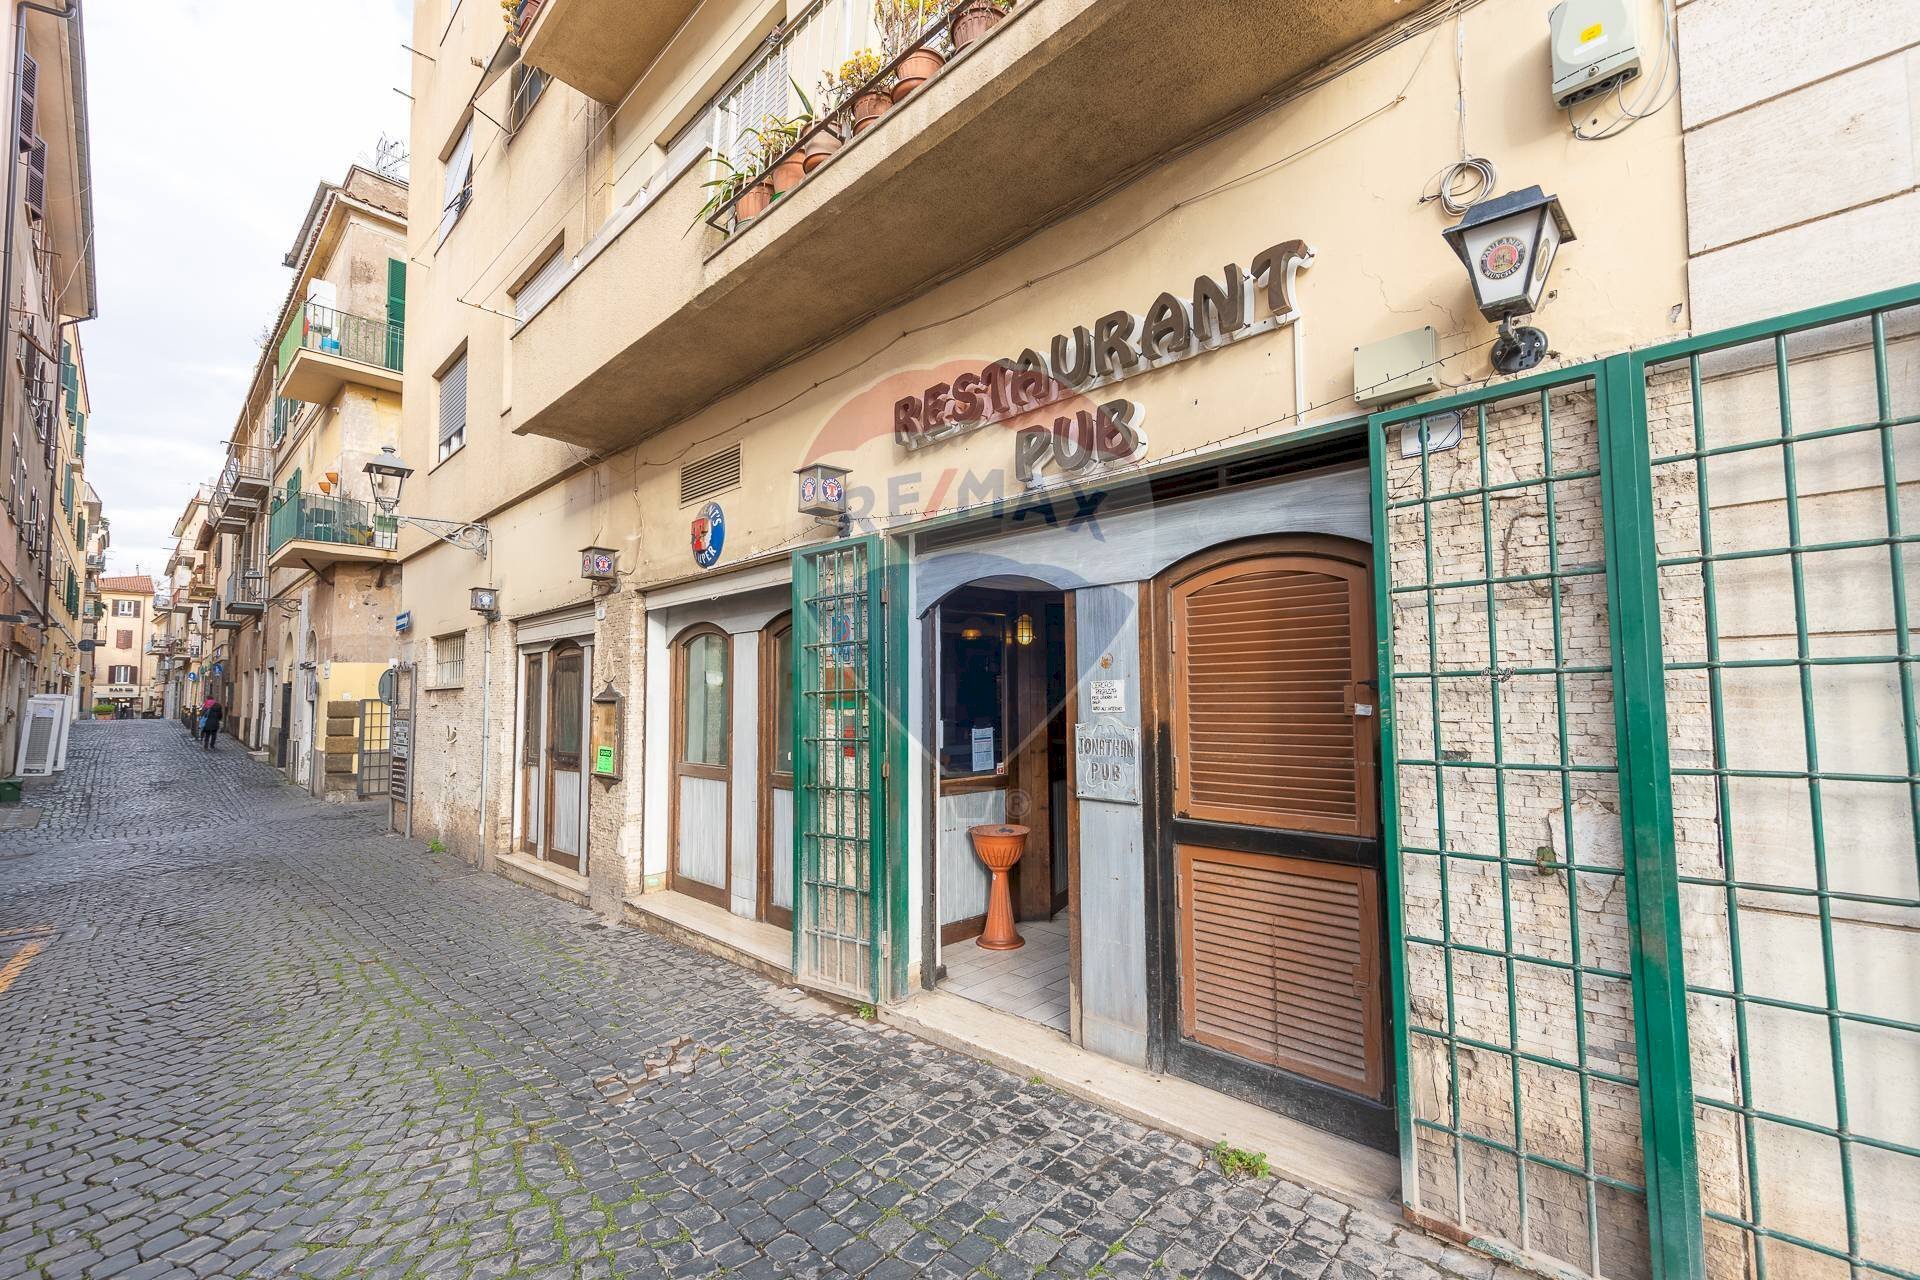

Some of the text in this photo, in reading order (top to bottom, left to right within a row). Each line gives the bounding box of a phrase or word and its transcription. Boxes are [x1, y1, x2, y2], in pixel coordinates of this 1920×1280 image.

[894, 239, 1315, 446] RESTAURANT
[1015, 398, 1146, 483] PUB
[1078, 736, 1135, 758] JONATHAN
[1091, 761, 1121, 781] PUB
